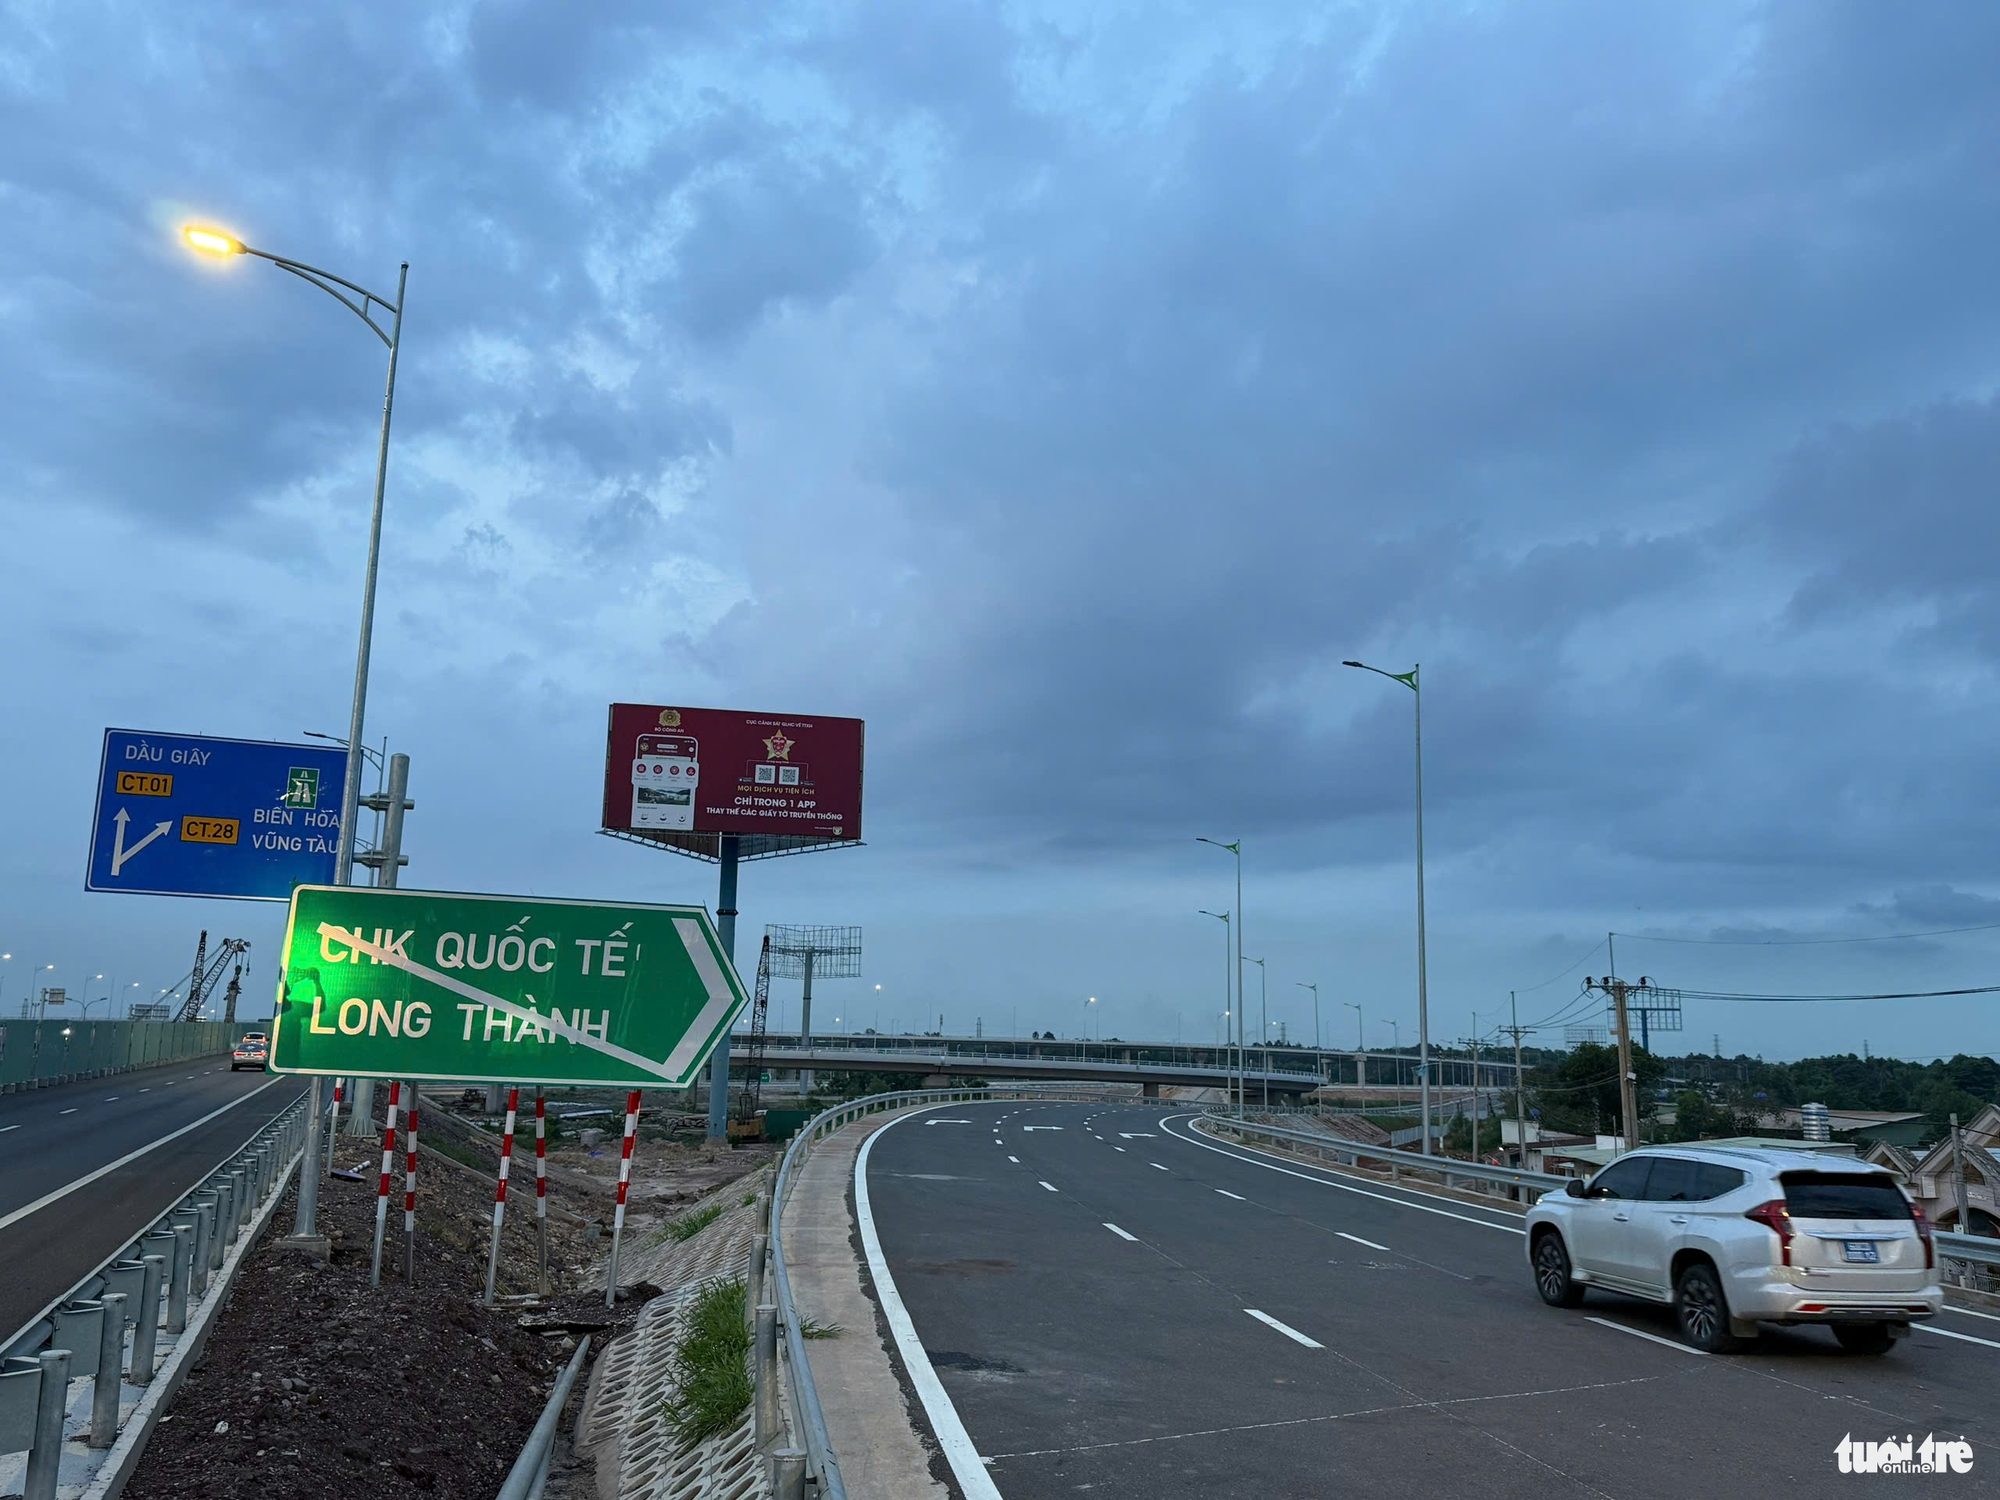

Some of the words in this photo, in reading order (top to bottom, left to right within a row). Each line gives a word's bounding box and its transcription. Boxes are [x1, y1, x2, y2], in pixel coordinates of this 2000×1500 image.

[125, 739, 163, 762] DẦU
[171, 747, 211, 766] GIÂY
[122, 774, 168, 793] CT.01
[706, 807, 725, 815] THAY
[726, 807, 740, 815] THẾ
[741, 808, 757, 816] CÁC
[734, 795, 752, 806] CHỈ
[754, 797, 787, 807] TRONG
[790, 799, 794, 808] 1
[797, 800, 816, 809] APP
[253, 806, 293, 826] BIÊN
[186, 821, 234, 840] CT.28
[252, 831, 302, 852] VŨNG
[306, 834, 339, 854] TÀU
[318, 925, 416, 966] CHK
[435, 915, 557, 974] QUỐC
[574, 921, 635, 977] TẾ
[309, 996, 432, 1038] LONG
[456, 994, 610, 1044] THÀNH
